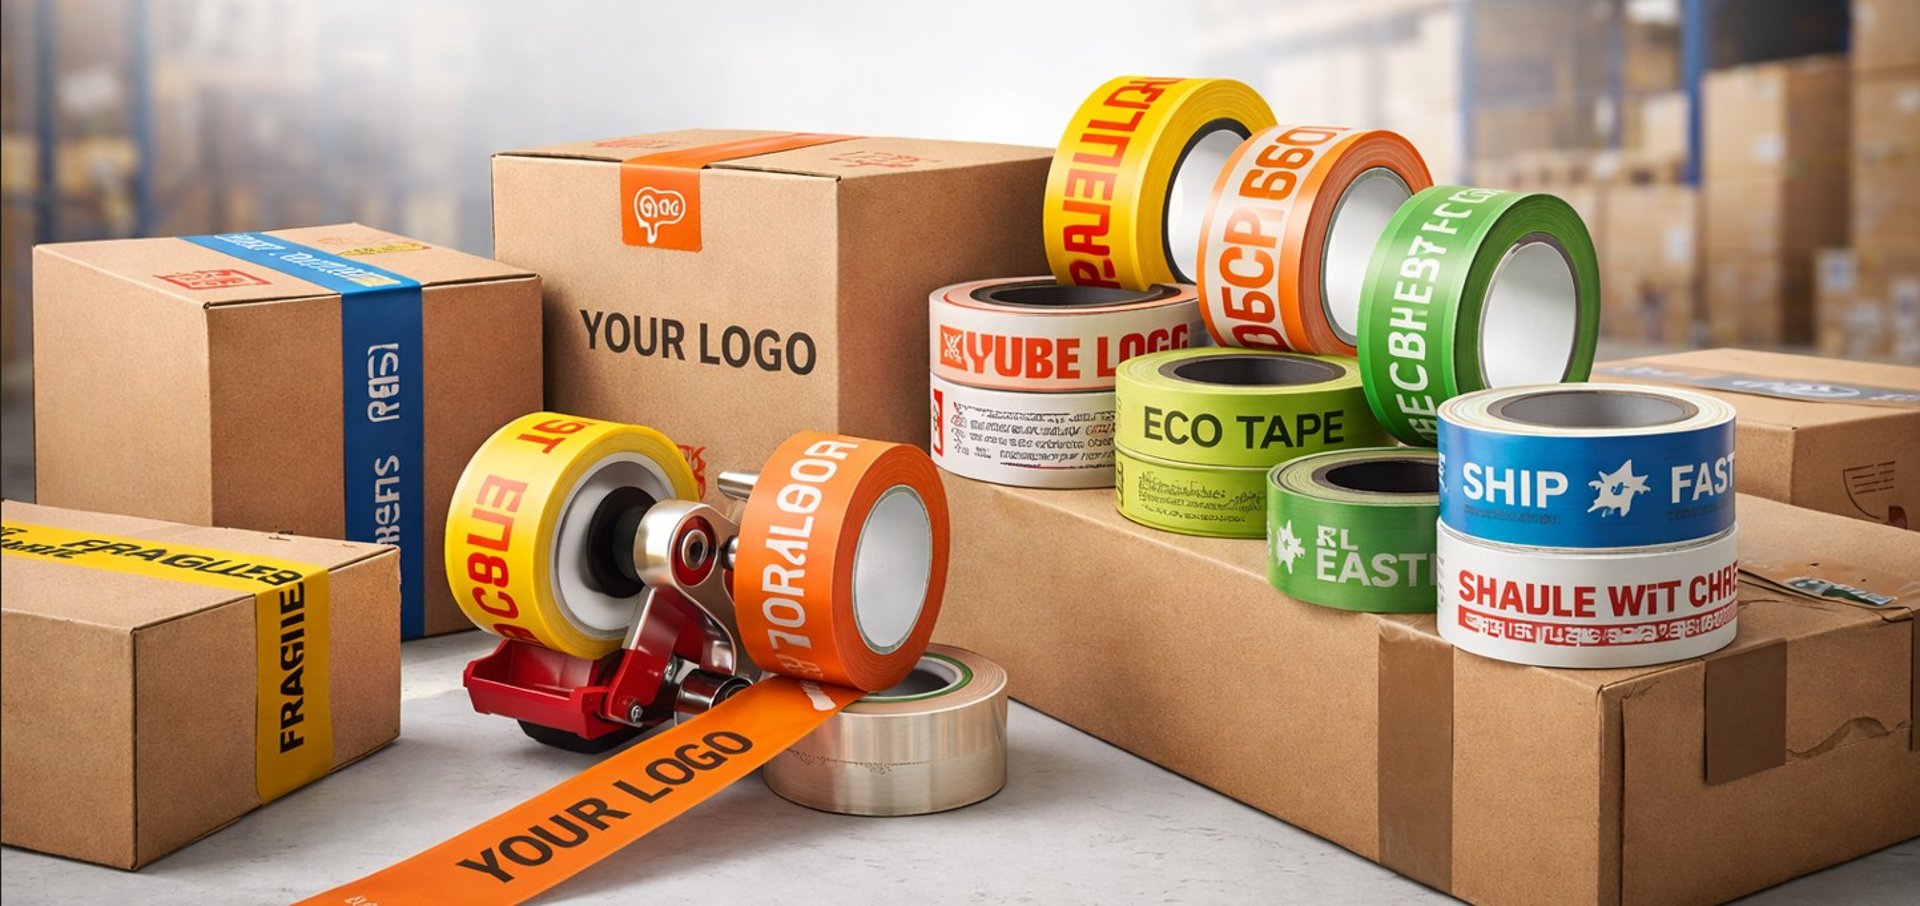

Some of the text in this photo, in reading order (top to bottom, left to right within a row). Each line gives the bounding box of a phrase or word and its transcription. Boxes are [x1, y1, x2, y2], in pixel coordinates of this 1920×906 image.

[579, 309, 817, 376] YOUR LOGO
[967, 330, 1081, 380] YUBE
[1143, 407, 1223, 447] ECO
[1235, 410, 1345, 450] TAPE
[1462, 461, 1569, 508] SHIP
[1458, 569, 1597, 618] SHAULE
[455, 730, 754, 884] YOUR LOGO
